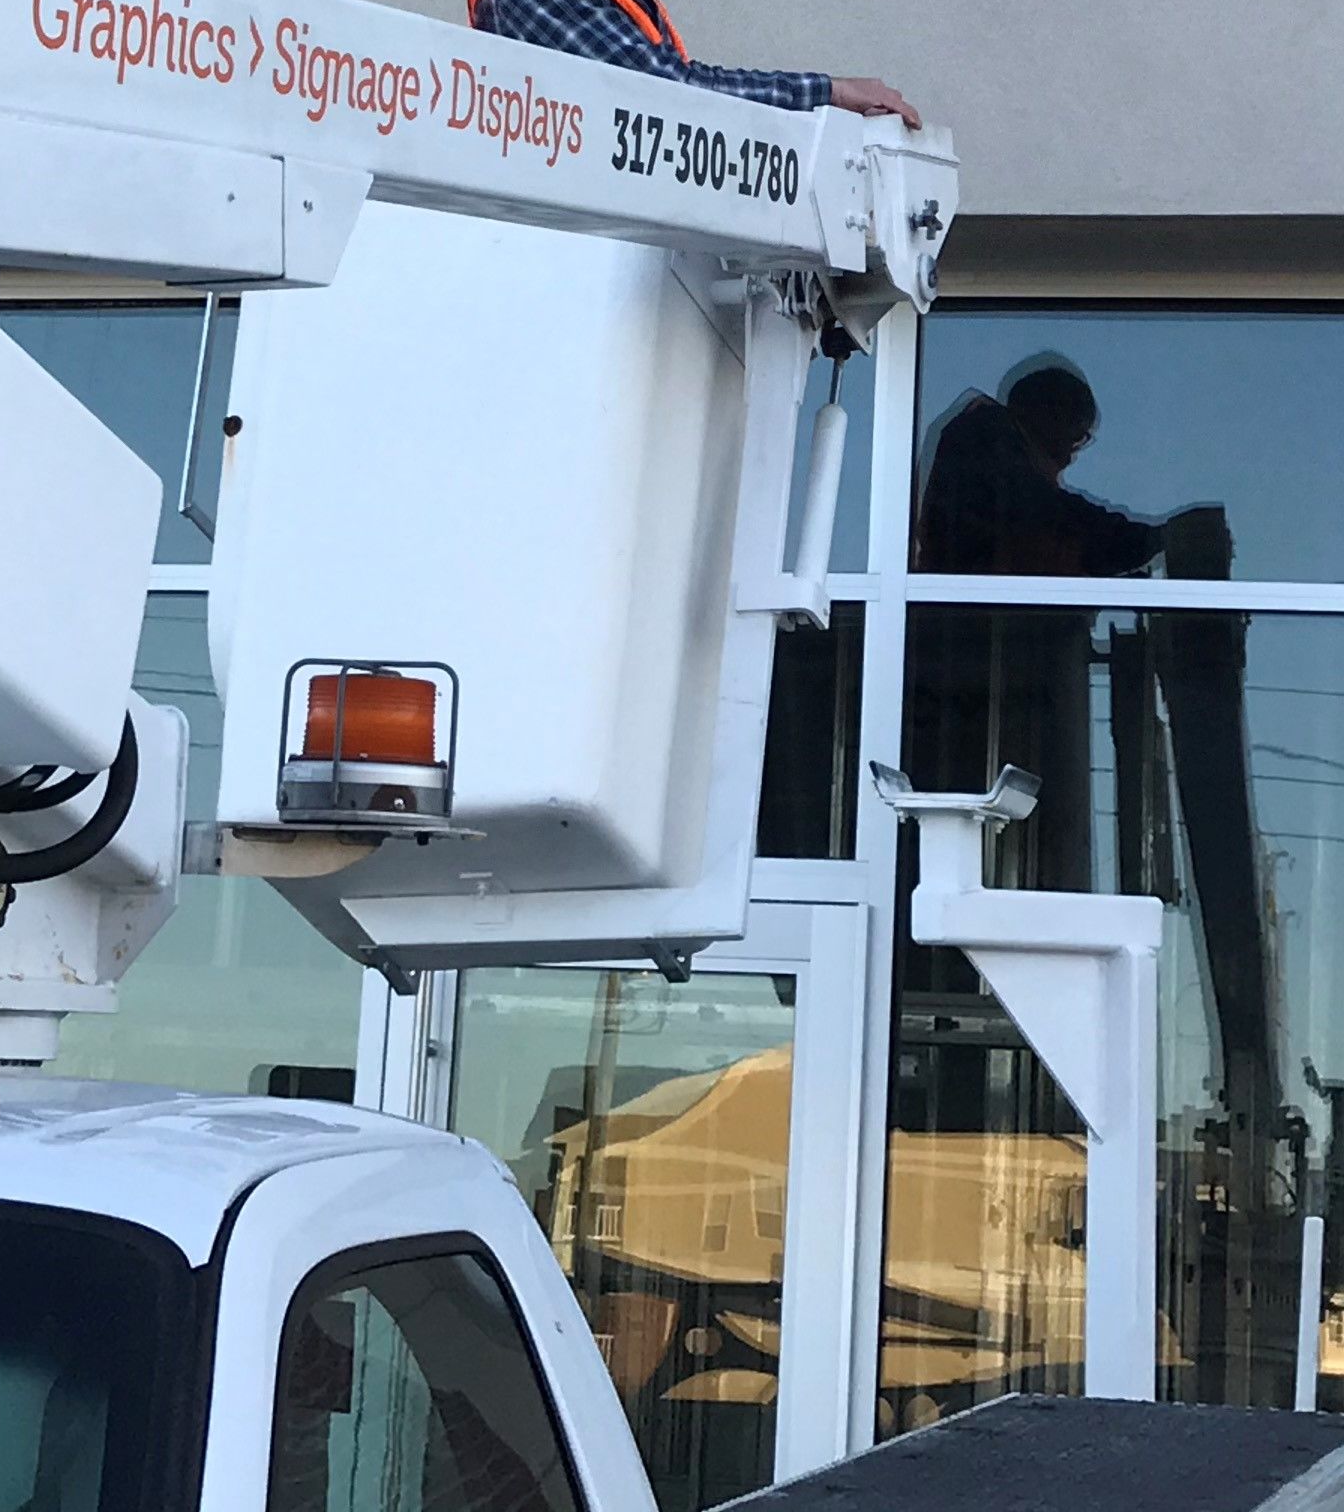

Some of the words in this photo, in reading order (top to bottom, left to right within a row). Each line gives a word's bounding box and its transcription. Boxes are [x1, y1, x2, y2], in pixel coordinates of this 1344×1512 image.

[274, 18, 421, 135] Signage
[448, 58, 584, 167] Displays
[612, 108, 800, 206] 317-300-1780
